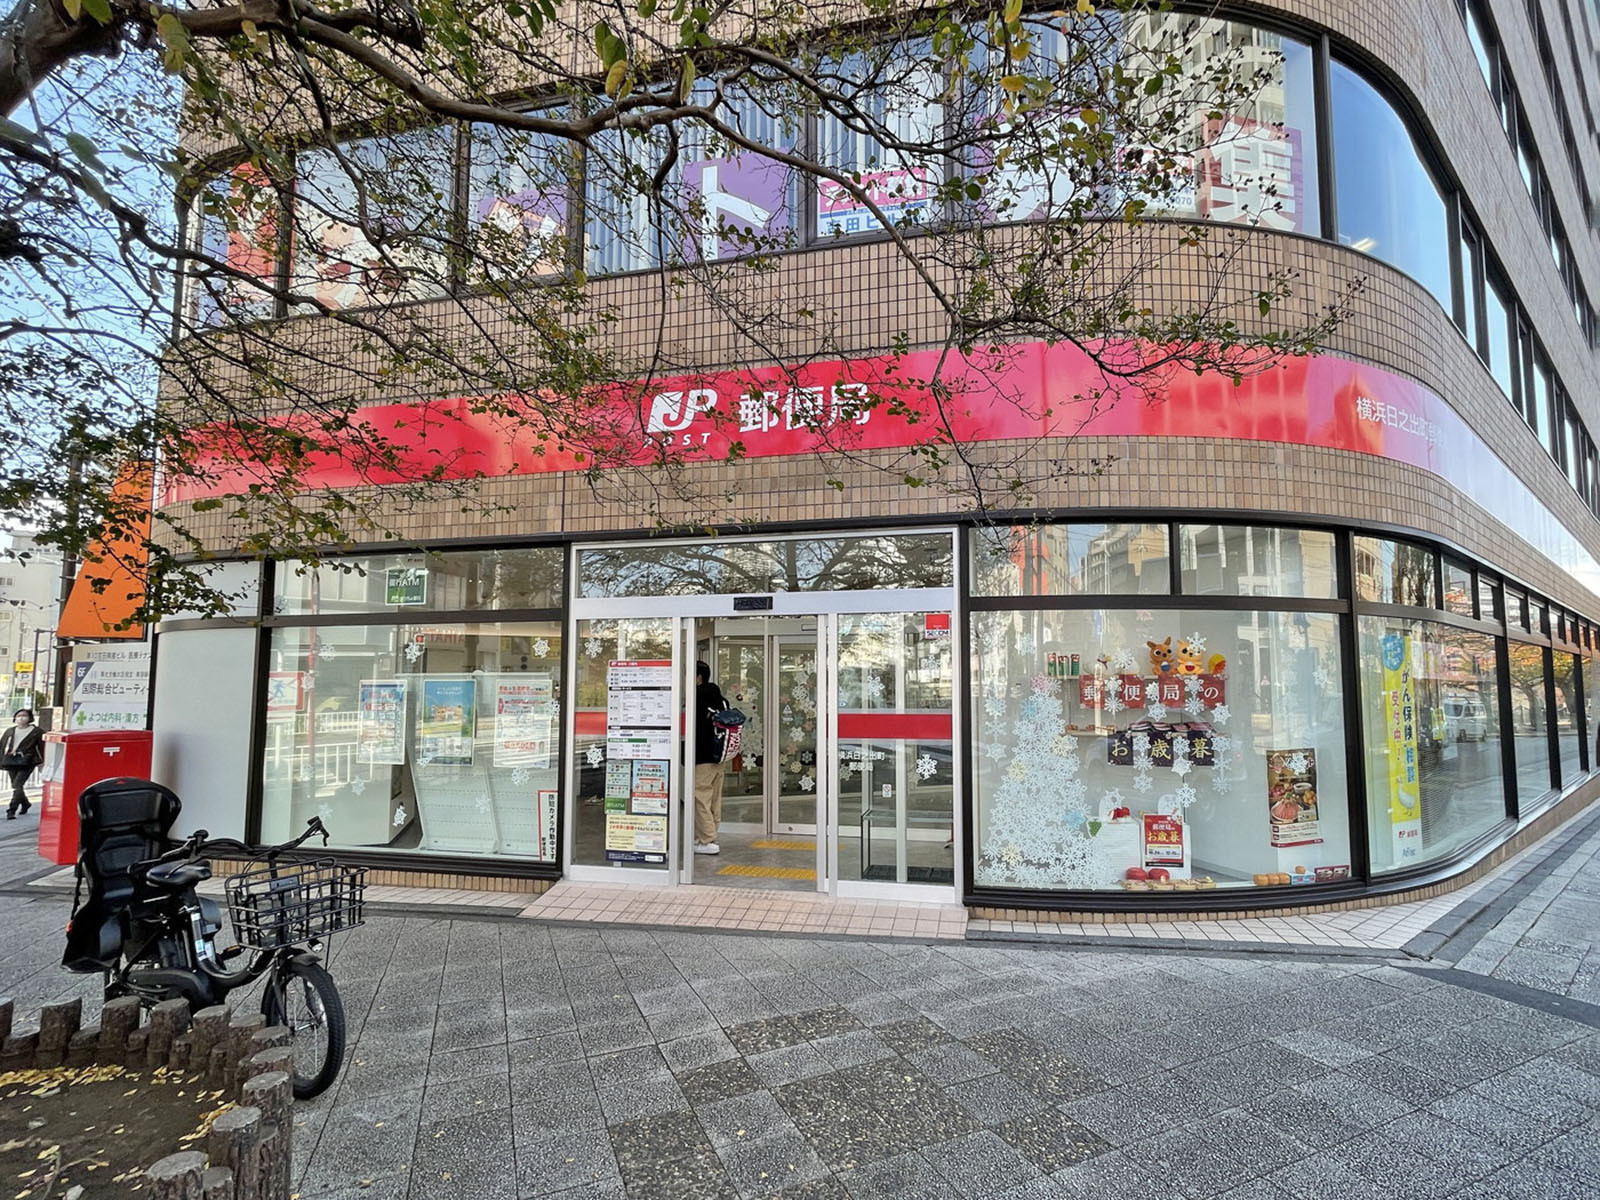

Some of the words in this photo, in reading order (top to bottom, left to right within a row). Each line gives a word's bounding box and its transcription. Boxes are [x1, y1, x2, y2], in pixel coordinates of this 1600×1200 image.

[646, 388, 718, 433] JP
[739, 382, 871, 434] 郵便局
[1083, 683, 1219, 702] 郵便局の
[1111, 738, 1213, 760] お歳暮
